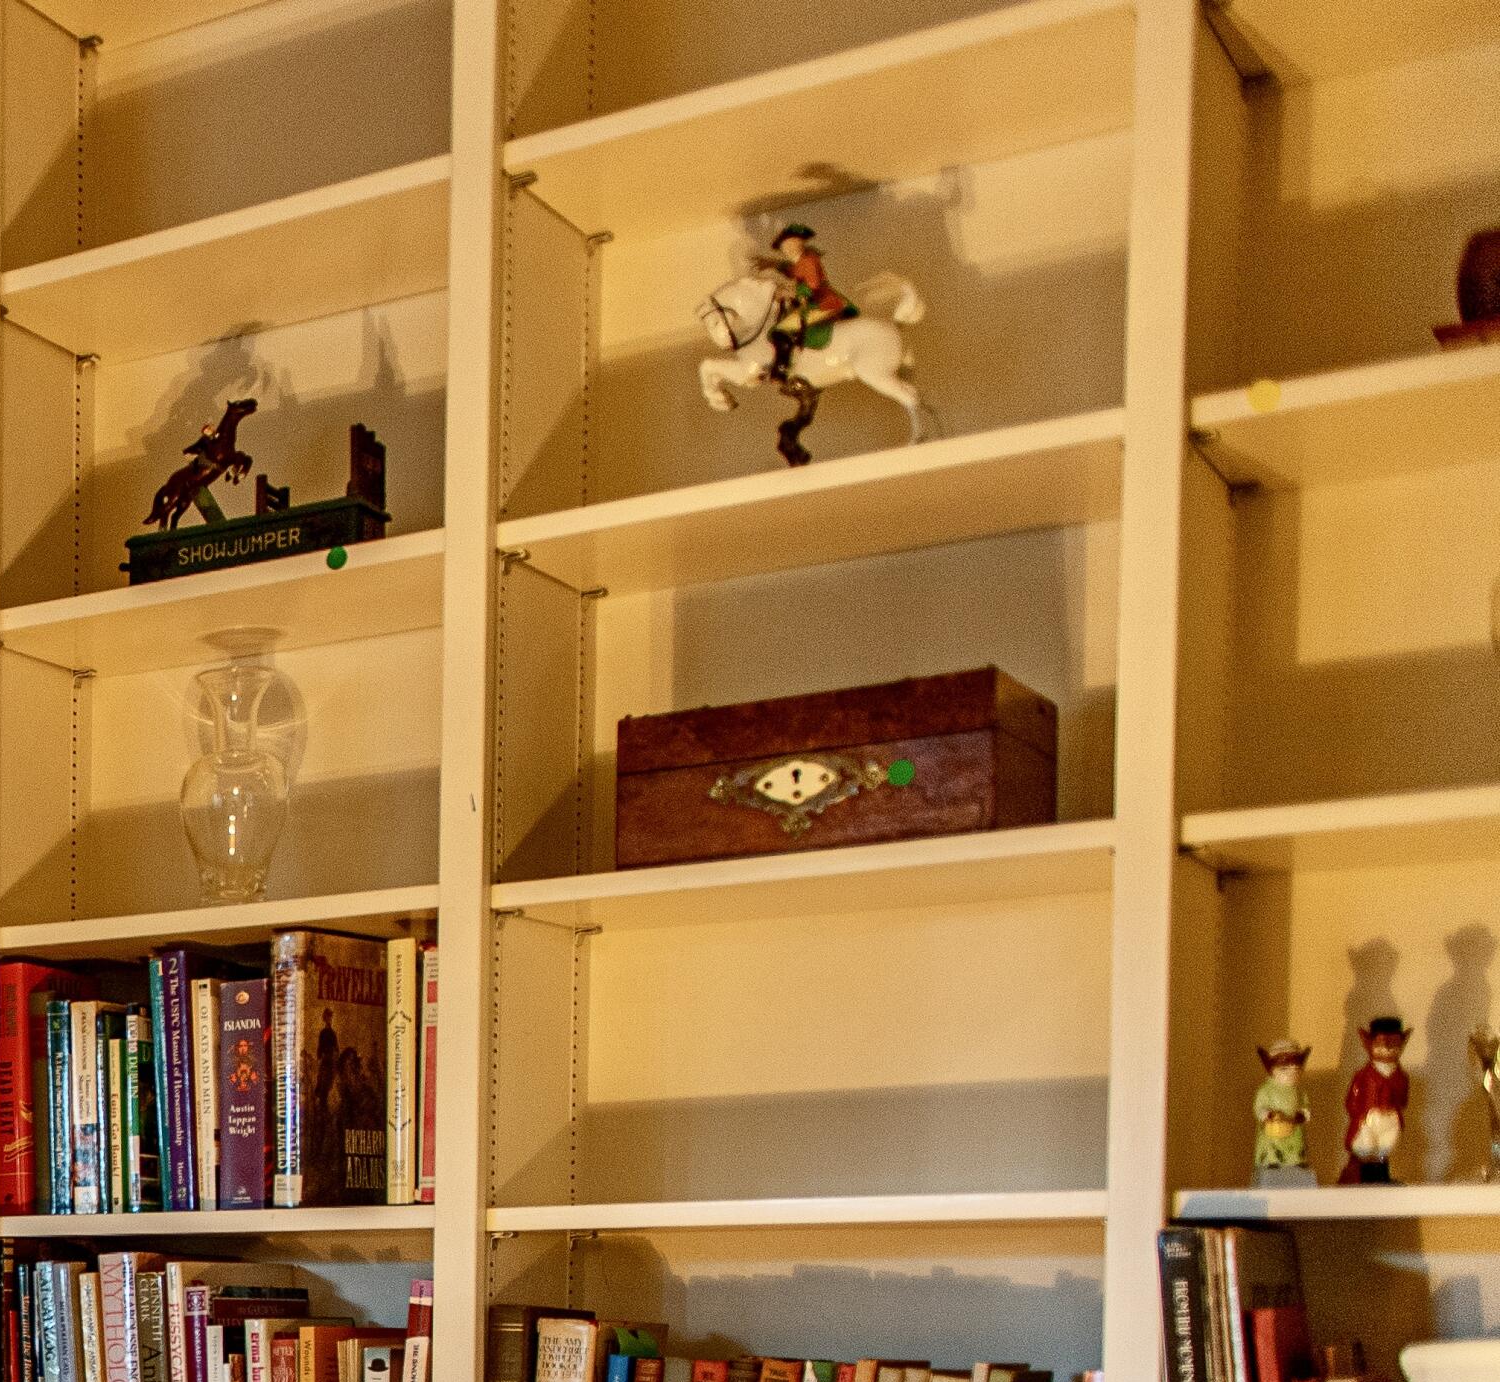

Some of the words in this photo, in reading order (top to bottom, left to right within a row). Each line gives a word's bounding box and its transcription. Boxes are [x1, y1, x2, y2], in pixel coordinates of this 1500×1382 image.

[178, 527, 301, 566] SHOWJUMPER
[170, 976, 179, 995] The
[170, 999, 179, 1025] USPC
[200, 1006, 209, 1018] OF
[224, 1018, 261, 1031] ISLANDIA
[172, 1030, 181, 1064] Manual
[201, 1025, 209, 1048] CATS
[128, 1056, 139, 1098] DUBLIN
[173, 1068, 182, 1077] of
[201, 1053, 210, 1078] AND
[202, 1083, 211, 1114] MEN
[230, 1105, 255, 1113] Austin
[0, 1101, 14, 1136] HEAT
[173, 1080, 184, 1146] Horsemanship
[229, 1126, 256, 1137] Wright
[277, 1122, 297, 1169] ADAMS
[177, 1162, 185, 1185] Harris
[139, 1278, 151, 1322] CLARK
[150, 1278, 162, 1342] KENNETH
[23, 1319, 31, 1338] and
[250, 1332, 262, 1364] erma
[303, 1340, 312, 1375] Wounds
